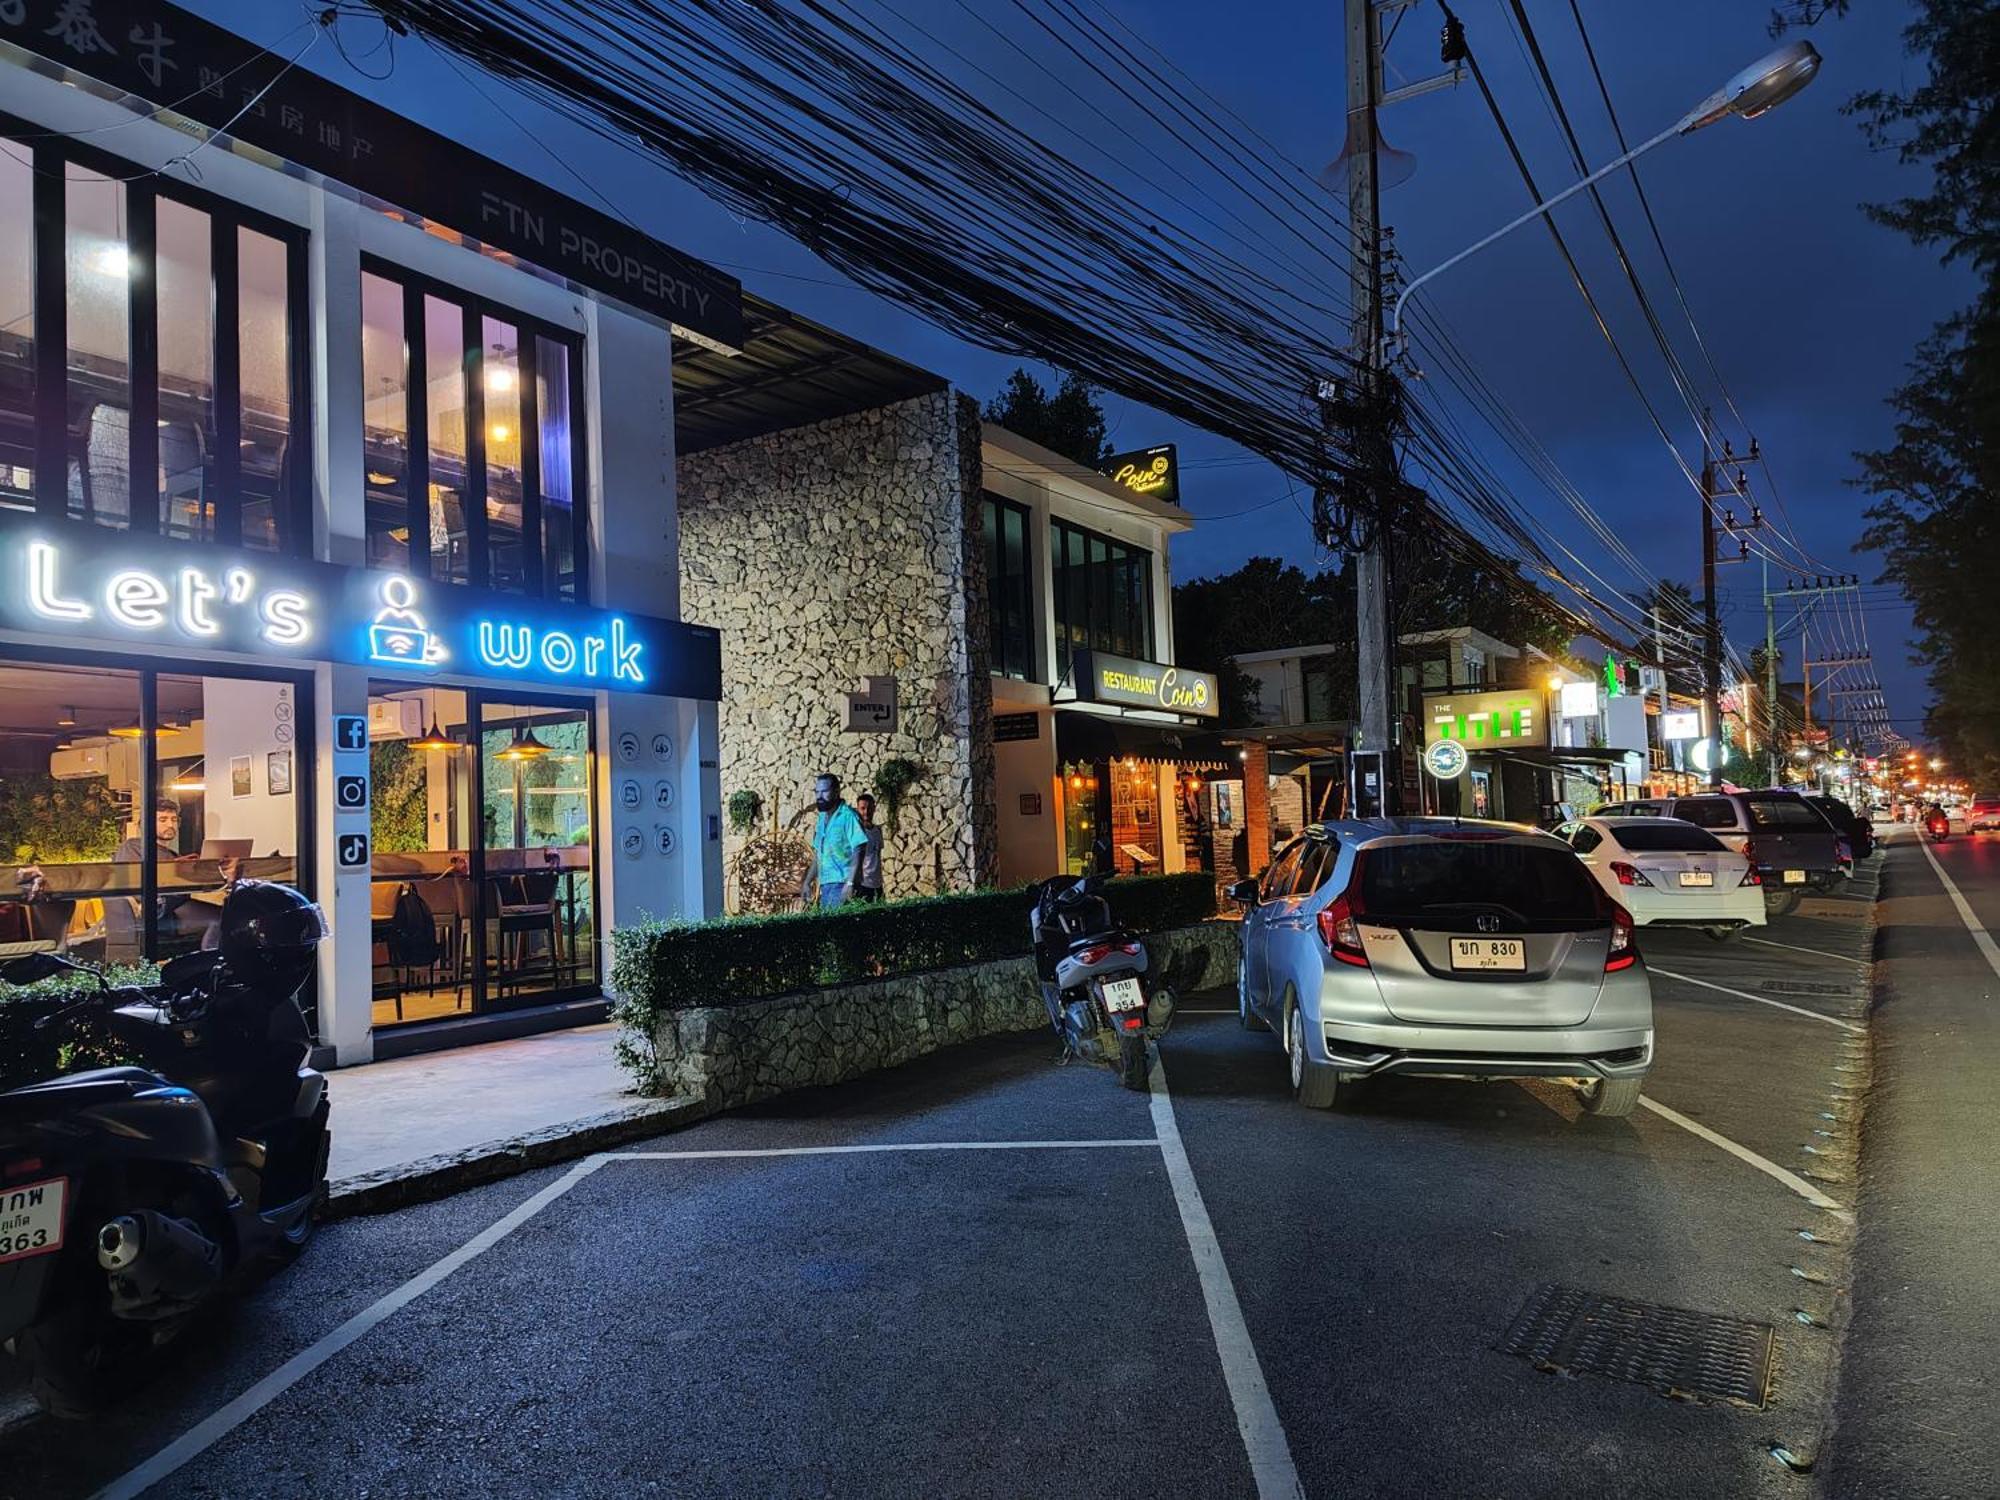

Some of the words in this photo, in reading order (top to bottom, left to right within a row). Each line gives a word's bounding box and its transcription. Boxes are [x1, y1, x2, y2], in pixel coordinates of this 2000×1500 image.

[481, 191, 545, 246] FTN
[560, 226, 711, 318] PROPERTY
[478, 617, 645, 683] work
[1103, 670, 1157, 696] RESTAURANT
[1159, 668, 1196, 707] Coin
[854, 703, 884, 712] ENTER
[1435, 705, 1452, 713] THE
[1434, 709, 1532, 739] TITLE
[1491, 942, 1517, 956] 830
